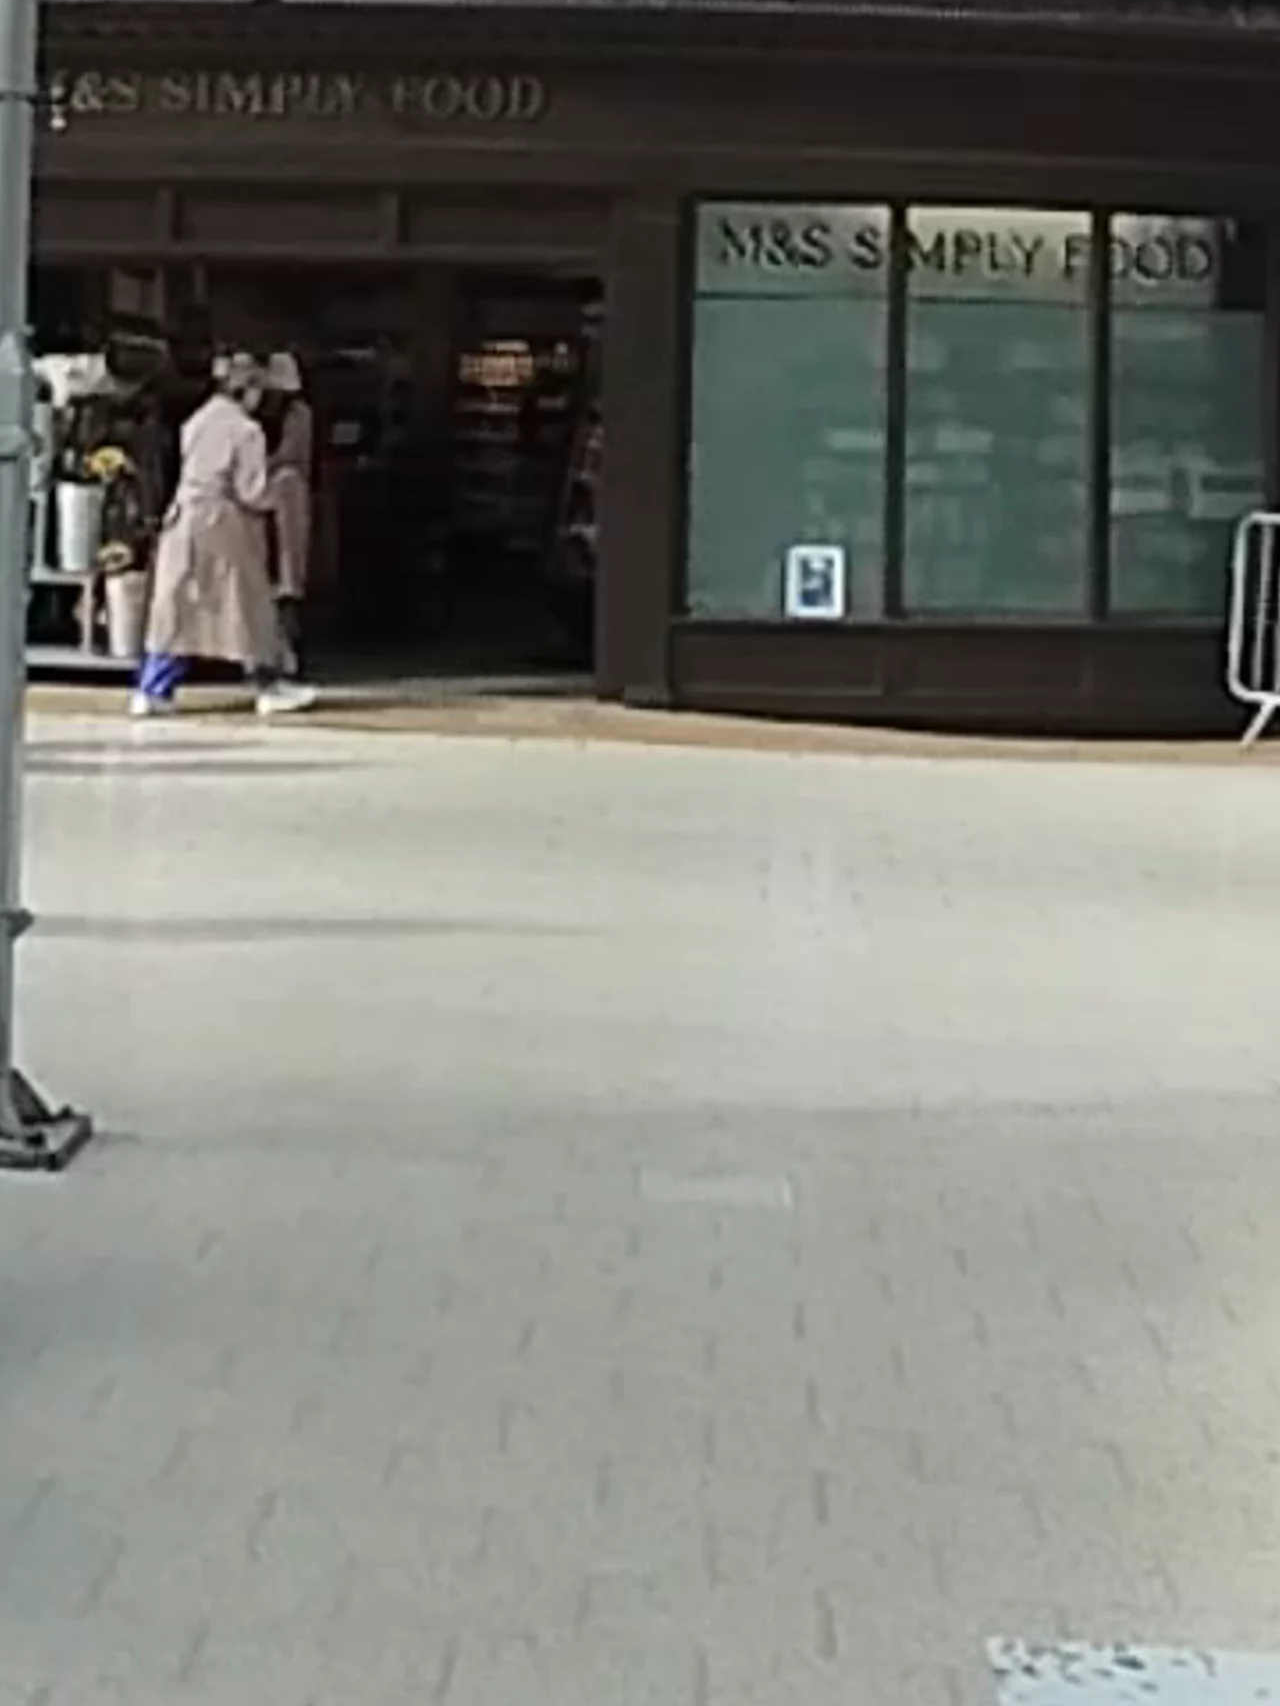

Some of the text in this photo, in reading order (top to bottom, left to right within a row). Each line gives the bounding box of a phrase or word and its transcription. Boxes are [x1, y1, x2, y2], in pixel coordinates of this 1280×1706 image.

[159, 69, 368, 116] SIMPLY
[390, 72, 548, 121] FOOD
[718, 218, 831, 270] M&S
[851, 226, 1046, 278] SMPLY
